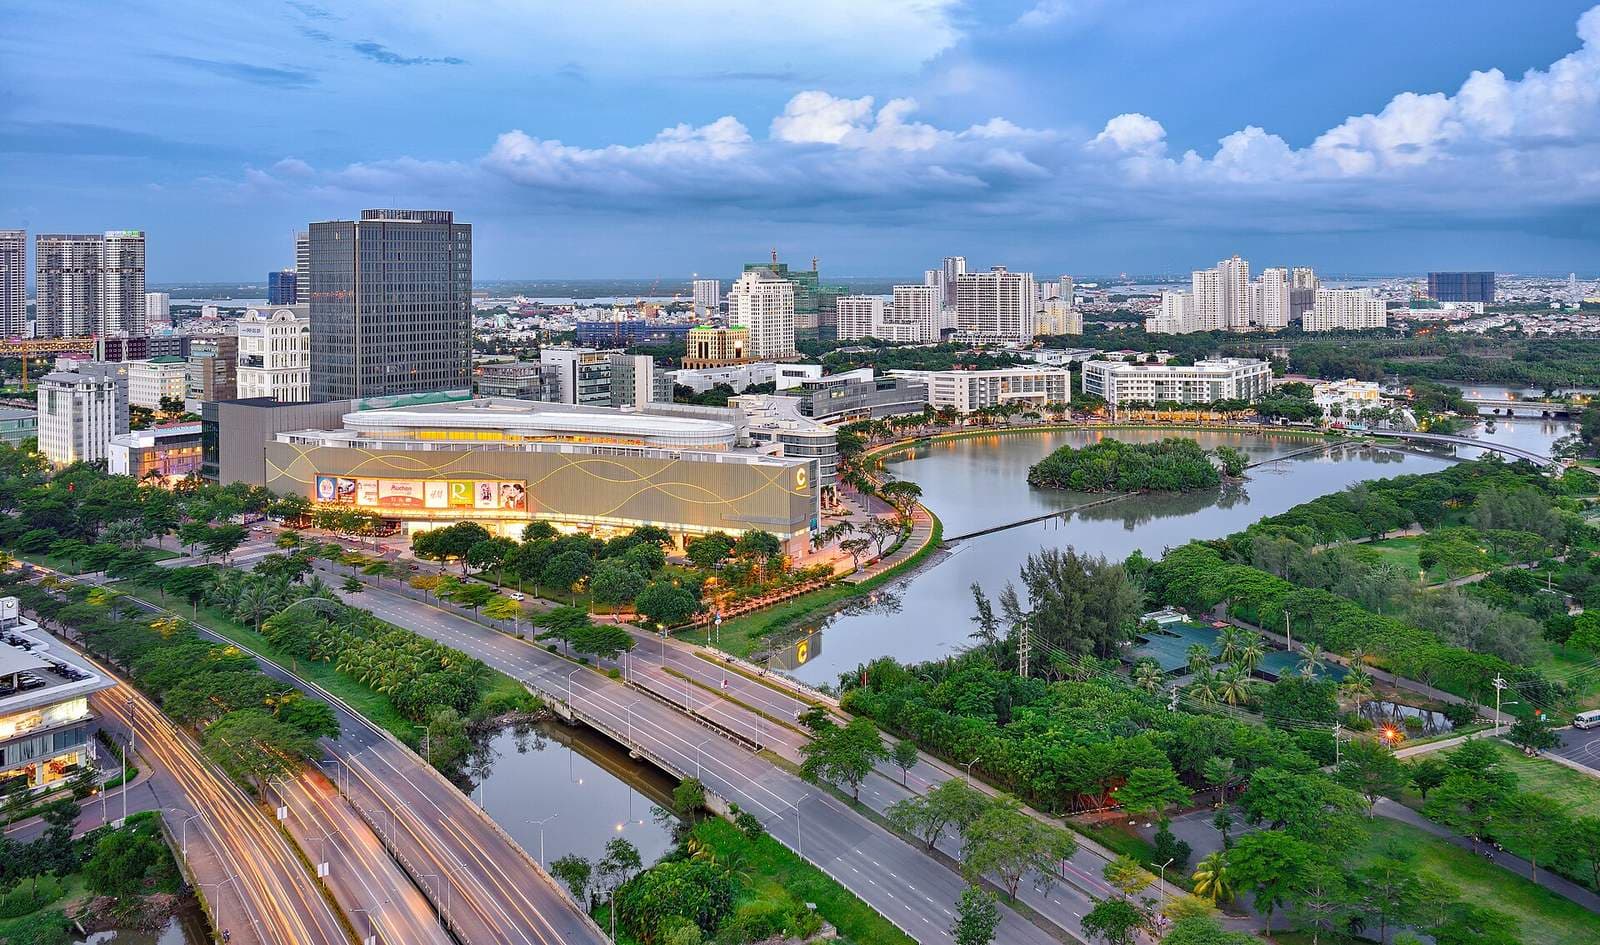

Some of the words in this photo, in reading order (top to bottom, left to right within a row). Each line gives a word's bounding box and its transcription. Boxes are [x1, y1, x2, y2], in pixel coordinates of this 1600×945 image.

[796, 467, 806, 486] C
[431, 489, 443, 499] HM
[452, 483, 469, 499] R
